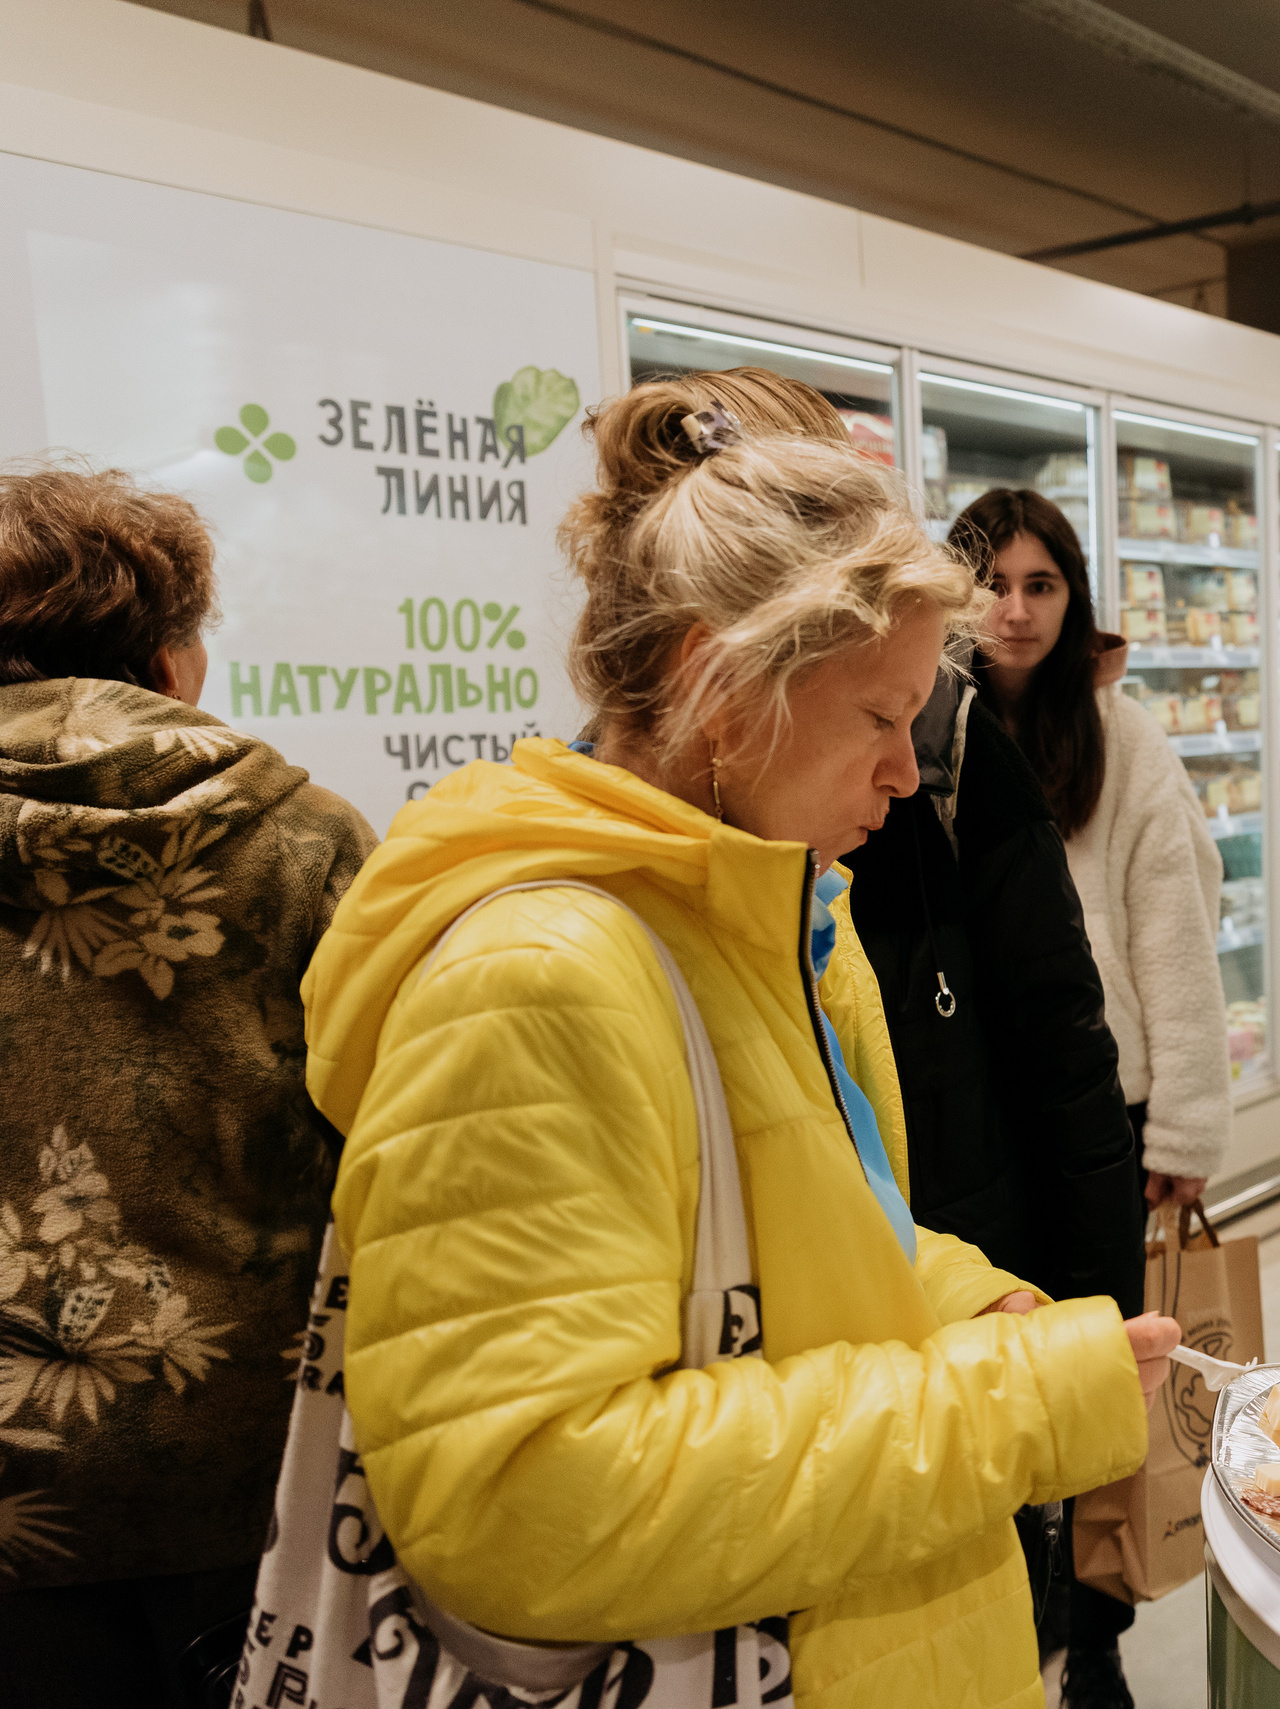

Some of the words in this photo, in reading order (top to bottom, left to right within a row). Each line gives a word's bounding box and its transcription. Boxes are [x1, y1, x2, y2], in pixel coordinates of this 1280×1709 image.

[317, 398, 527, 470] ЗЕЛЁНАЯ
[375, 465, 528, 526] ЛИНИЯ
[397, 597, 527, 652] 100%
[229, 660, 539, 718] НАТУРАЛЬНО
